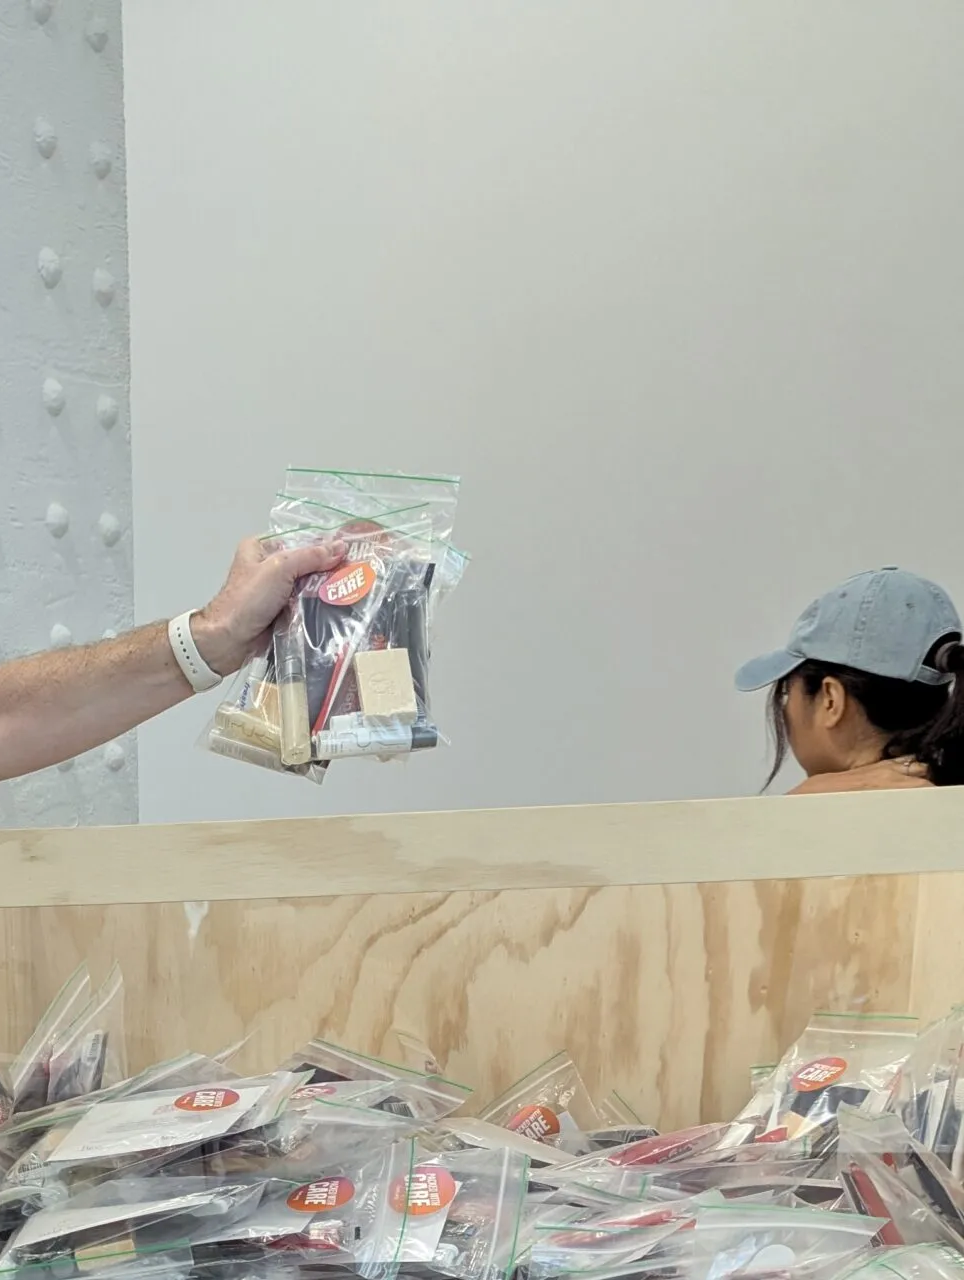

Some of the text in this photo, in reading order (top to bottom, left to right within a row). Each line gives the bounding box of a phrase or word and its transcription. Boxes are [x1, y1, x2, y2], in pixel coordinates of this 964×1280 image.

[327, 574, 366, 601] CARE
[796, 1067, 835, 1083] CARE
[192, 1091, 218, 1107] CARE
[304, 1181, 331, 1207] CARE
[329, 1180, 340, 1196] PACKED
[402, 1173, 426, 1208] CARE
[426, 1173, 441, 1207] PACKED WITH
